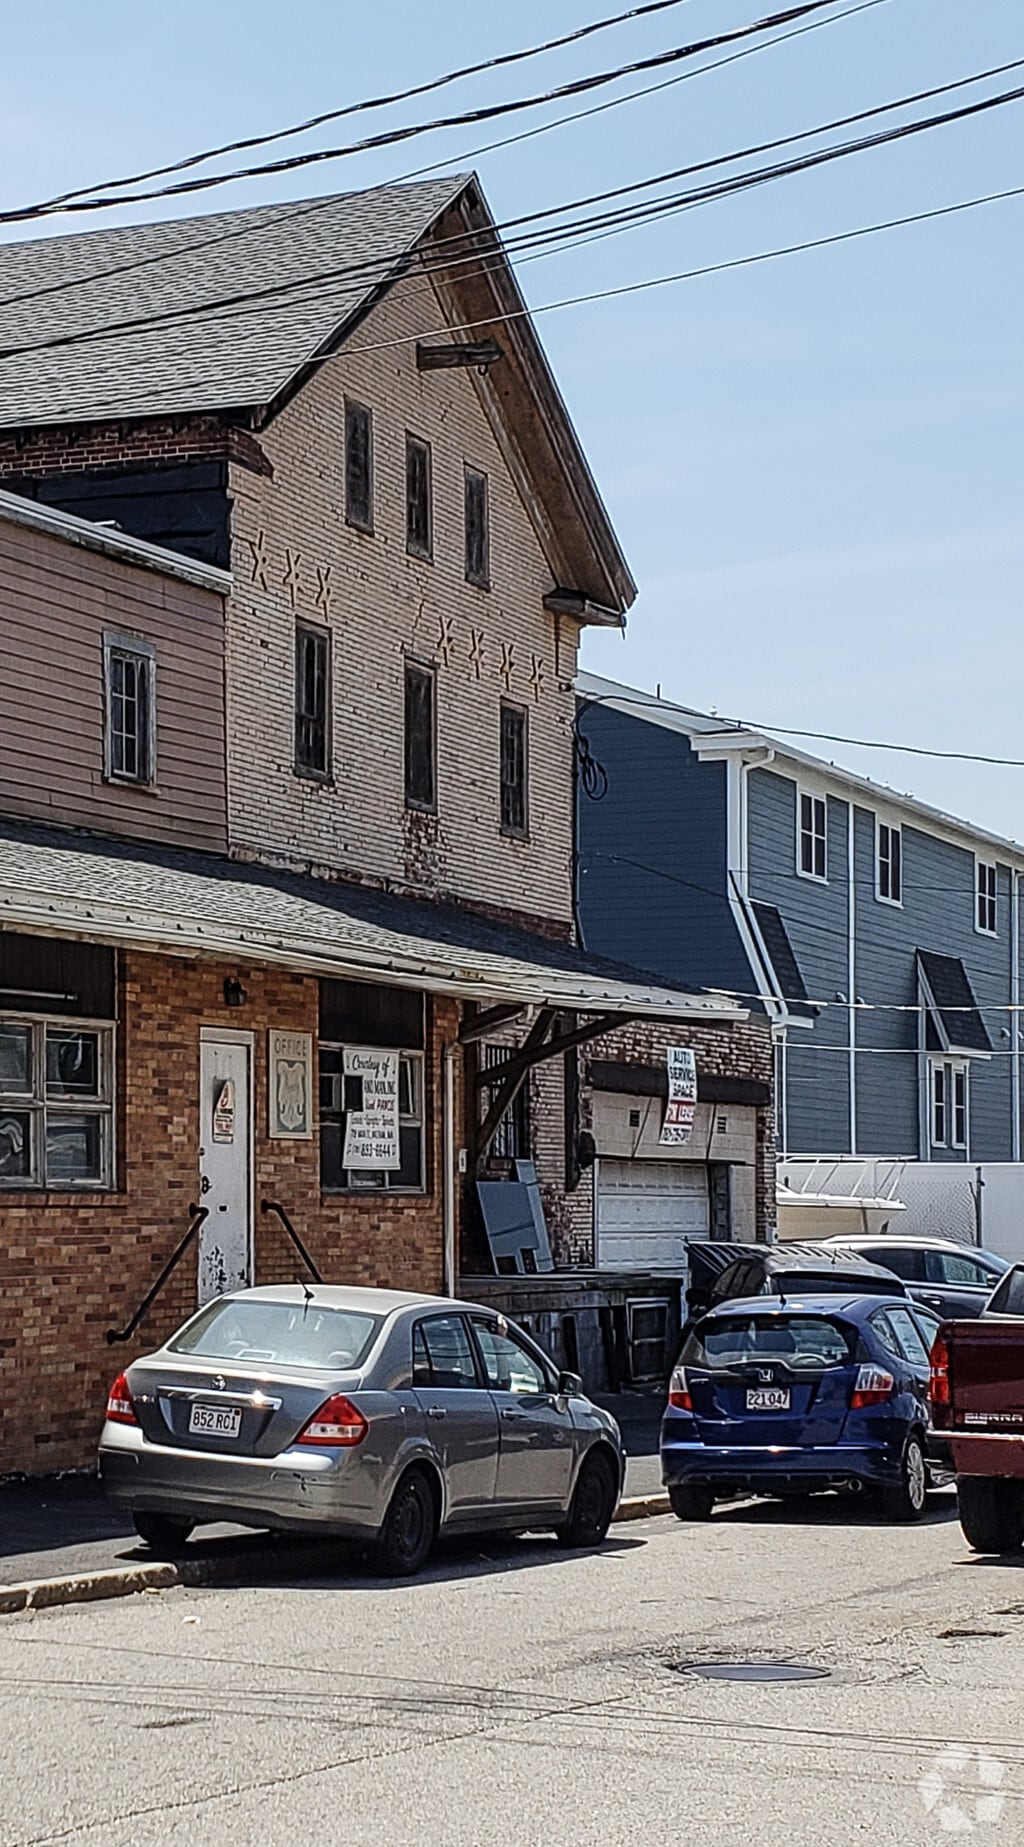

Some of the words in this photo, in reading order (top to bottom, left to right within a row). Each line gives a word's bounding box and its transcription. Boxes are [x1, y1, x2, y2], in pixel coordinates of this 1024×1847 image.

[274, 1037, 307, 1056] OFFICE
[673, 1050, 691, 1065] AUTO
[669, 1066, 696, 1081] SERVICE
[673, 1083, 694, 1098] SPACE
[193, 1411, 214, 1428] 852
